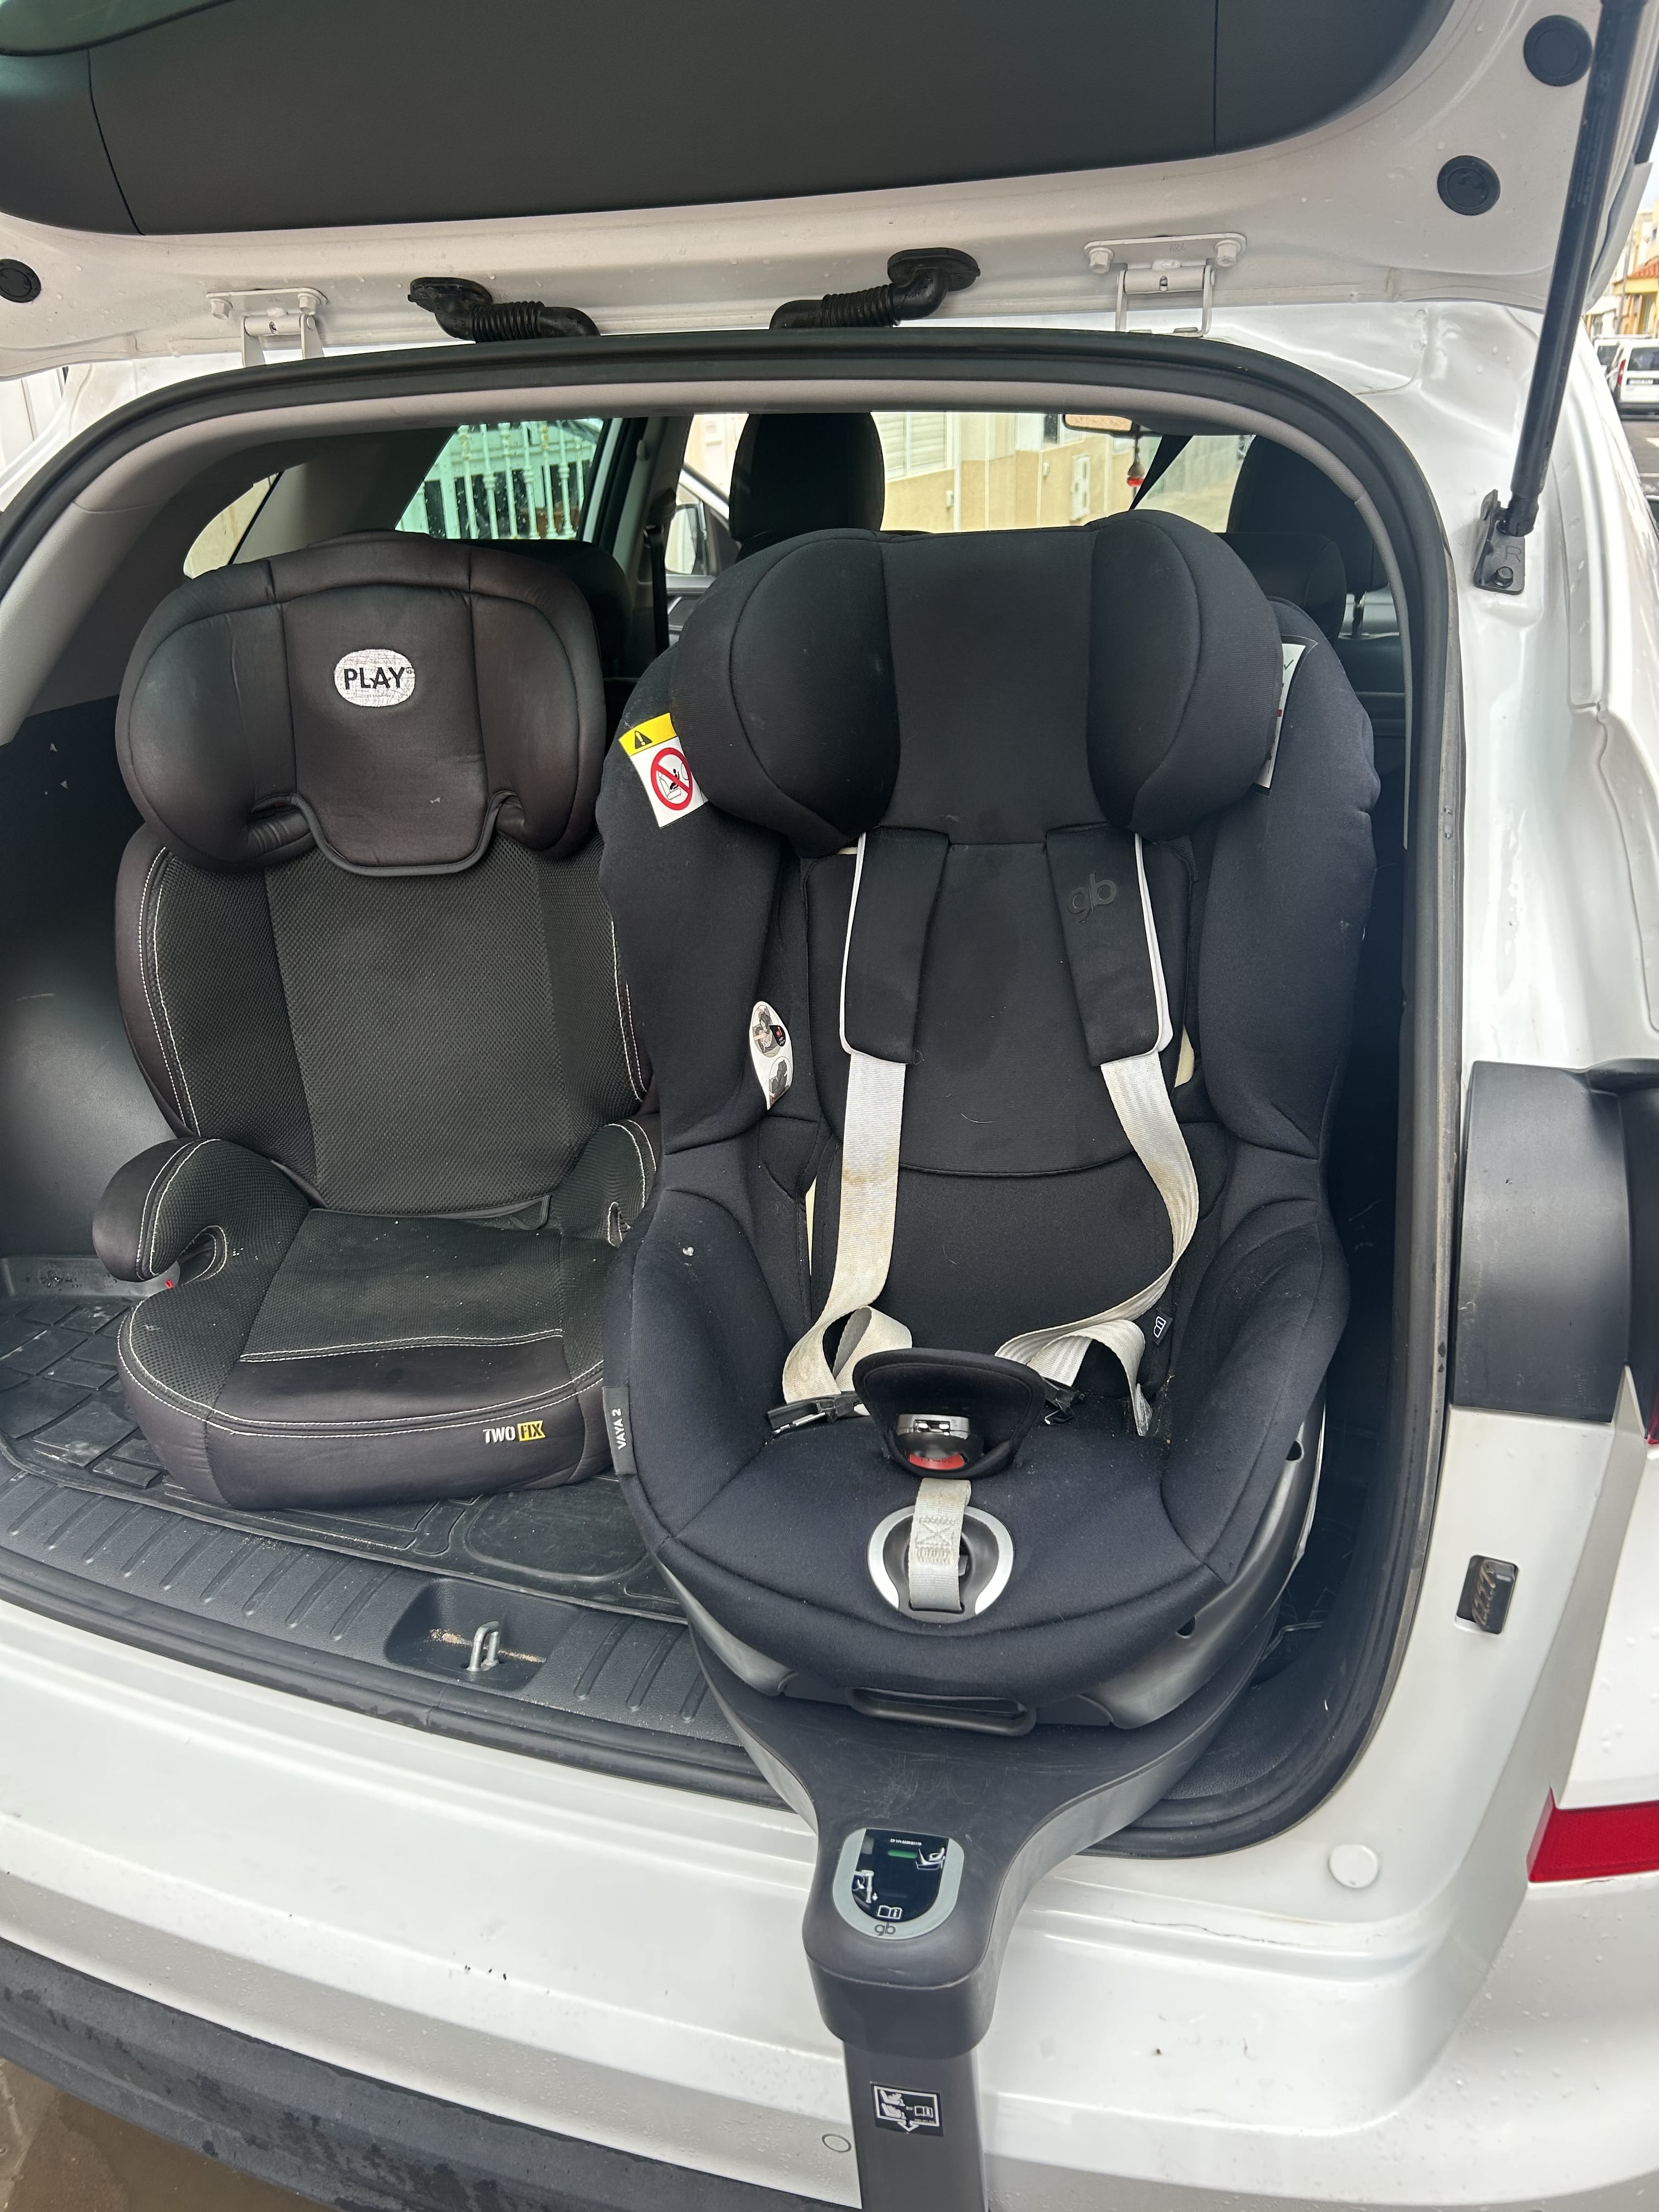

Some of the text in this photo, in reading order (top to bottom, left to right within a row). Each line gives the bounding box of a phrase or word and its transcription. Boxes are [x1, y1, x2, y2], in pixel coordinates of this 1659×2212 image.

[343, 666, 405, 690] PLAY
[1066, 873, 1117, 923] gb
[483, 1423, 543, 1443] TWO FIX
[612, 1408, 627, 1450] VAYA 2
[874, 1921, 896, 1936] gb
